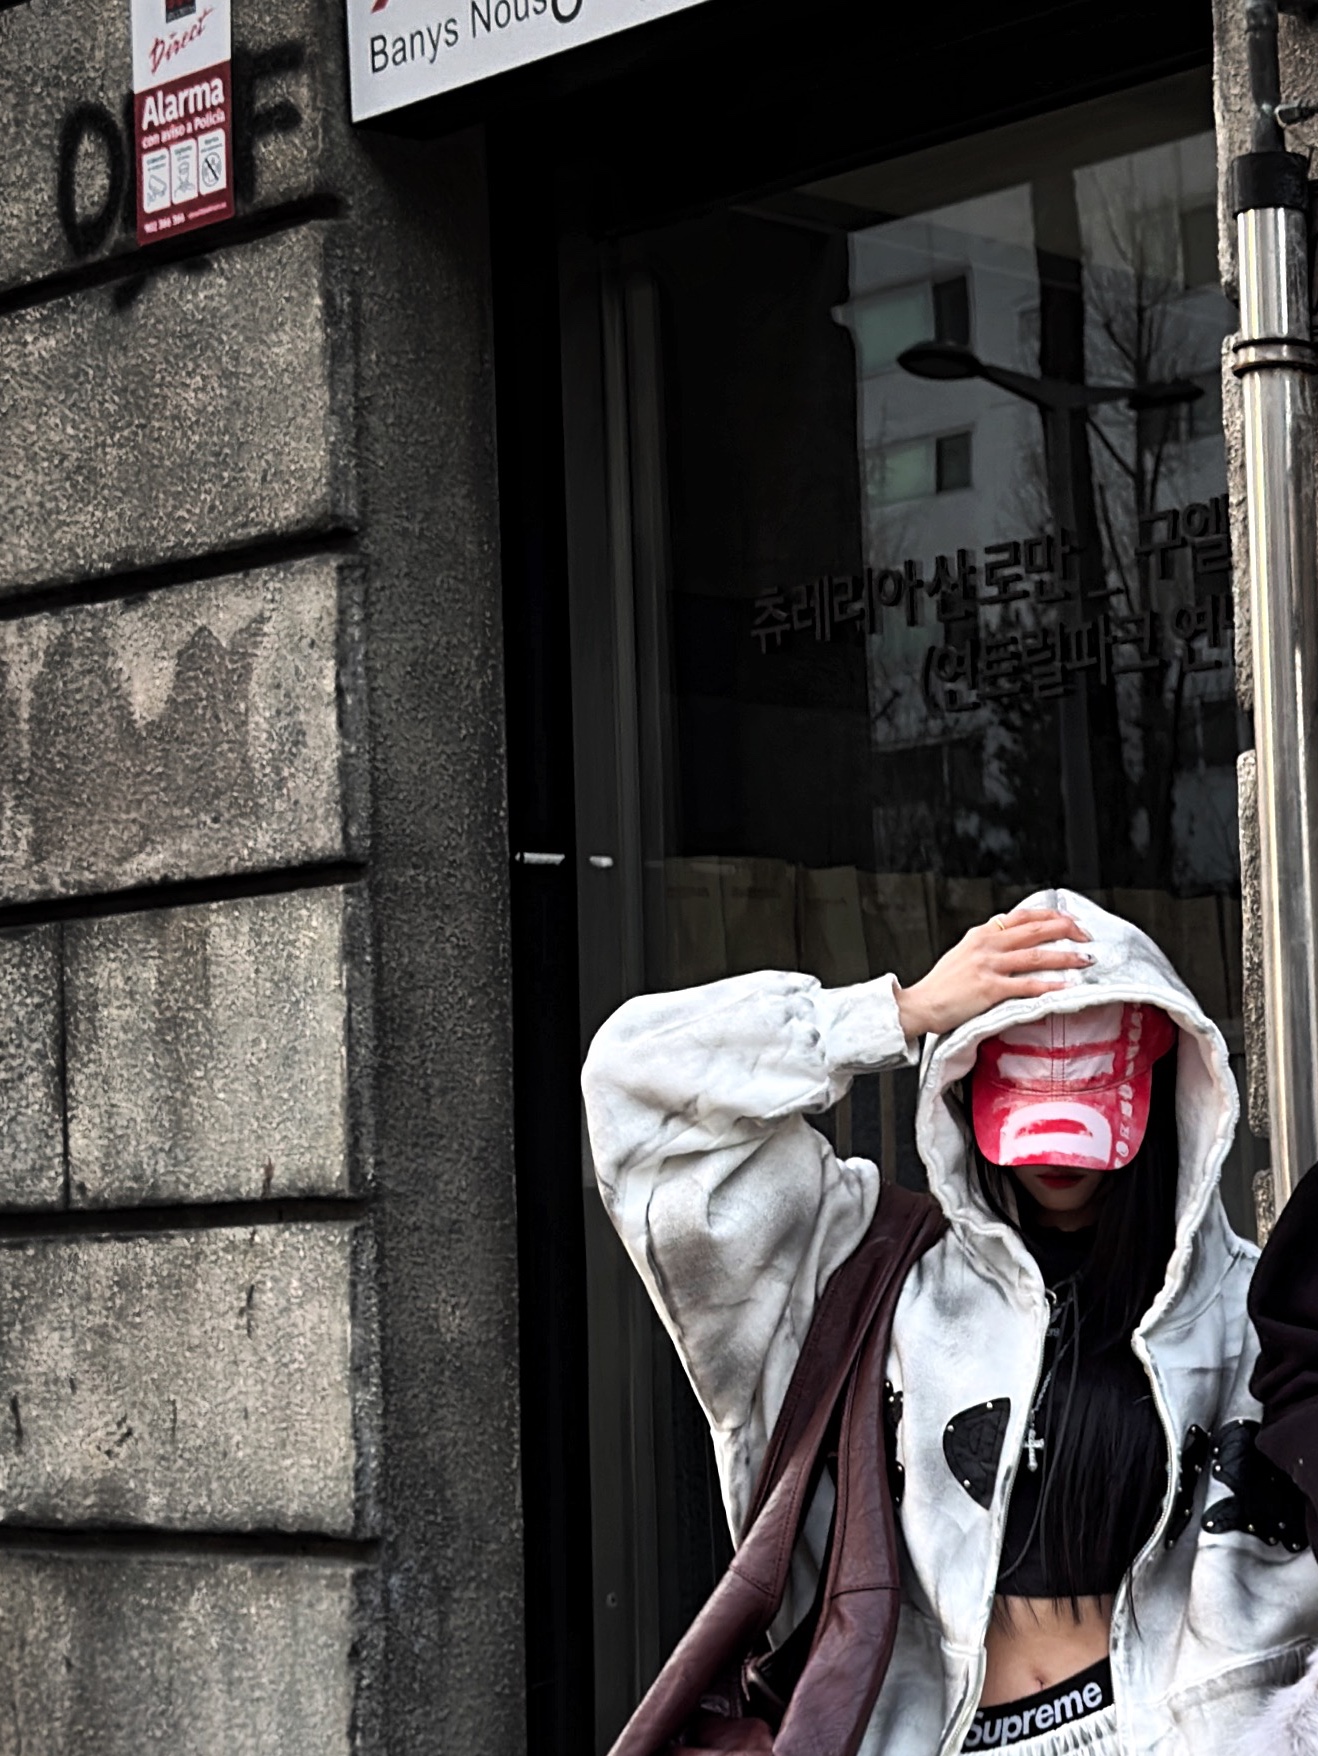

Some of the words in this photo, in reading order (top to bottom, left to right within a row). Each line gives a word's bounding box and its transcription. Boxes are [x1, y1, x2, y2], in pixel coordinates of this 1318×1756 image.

[370, 17, 459, 73] Banys
[142, 78, 225, 130] Alarma
[142, 133, 160, 149] con
[161, 124, 186, 143] aviso
[186, 122, 193, 134] a
[965, 1681, 1103, 1746] Supreme
